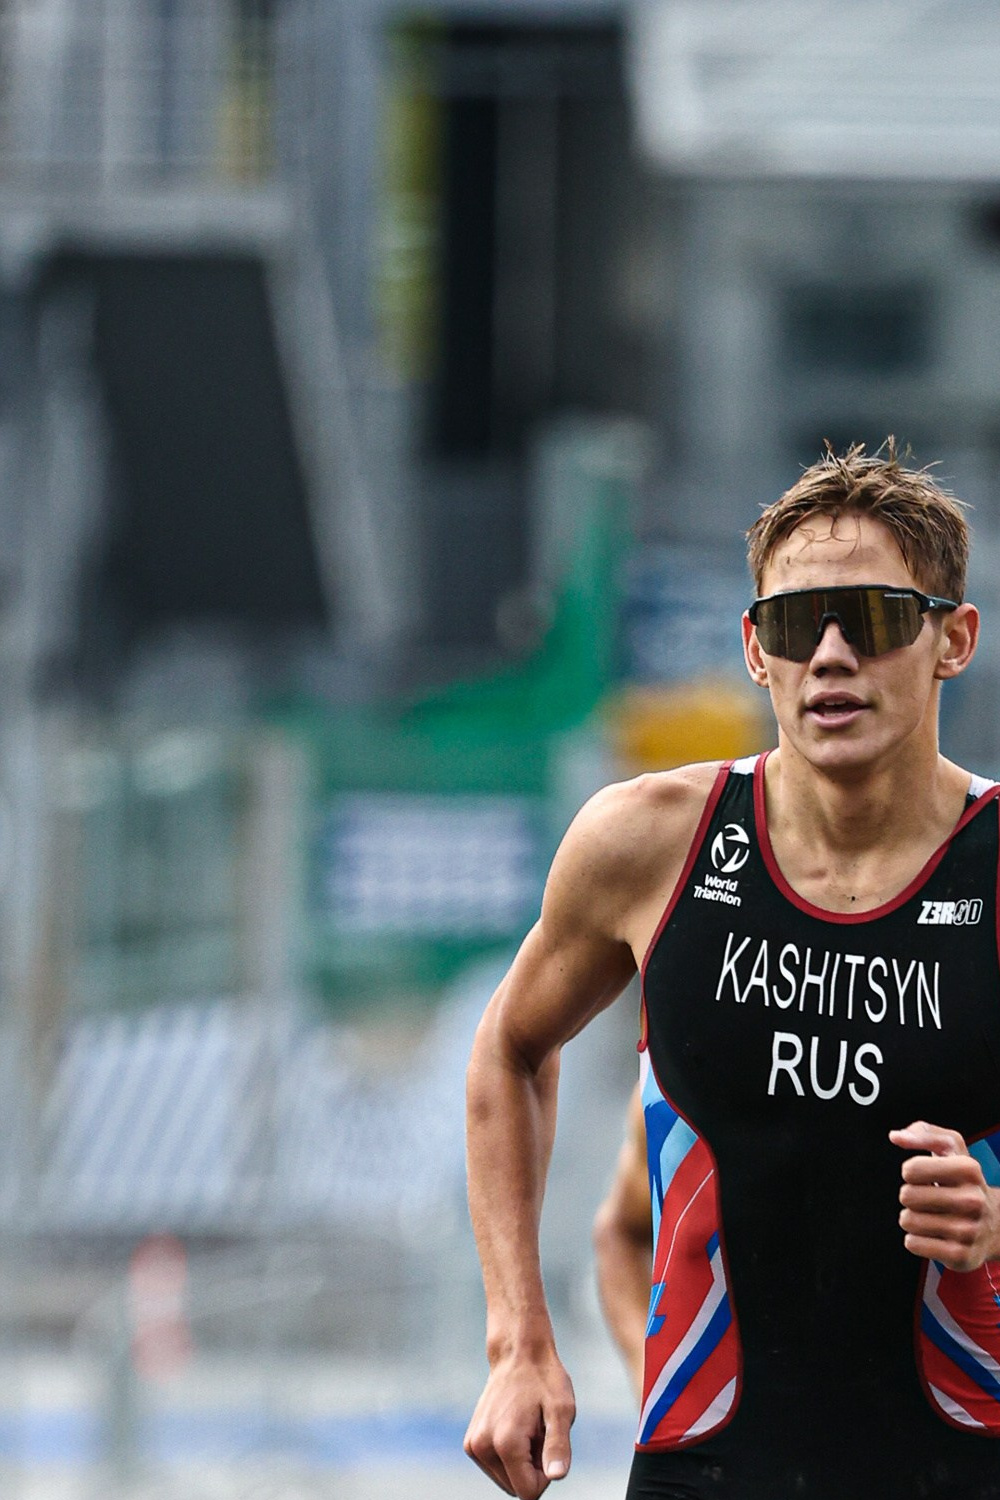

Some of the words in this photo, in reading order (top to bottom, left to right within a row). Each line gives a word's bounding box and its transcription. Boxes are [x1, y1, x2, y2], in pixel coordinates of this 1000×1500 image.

[693, 885, 742, 907] Triathlon
[704, 873, 739, 892] World
[715, 932, 942, 1030] KASHITSYN
[767, 1030, 884, 1106] RUS
